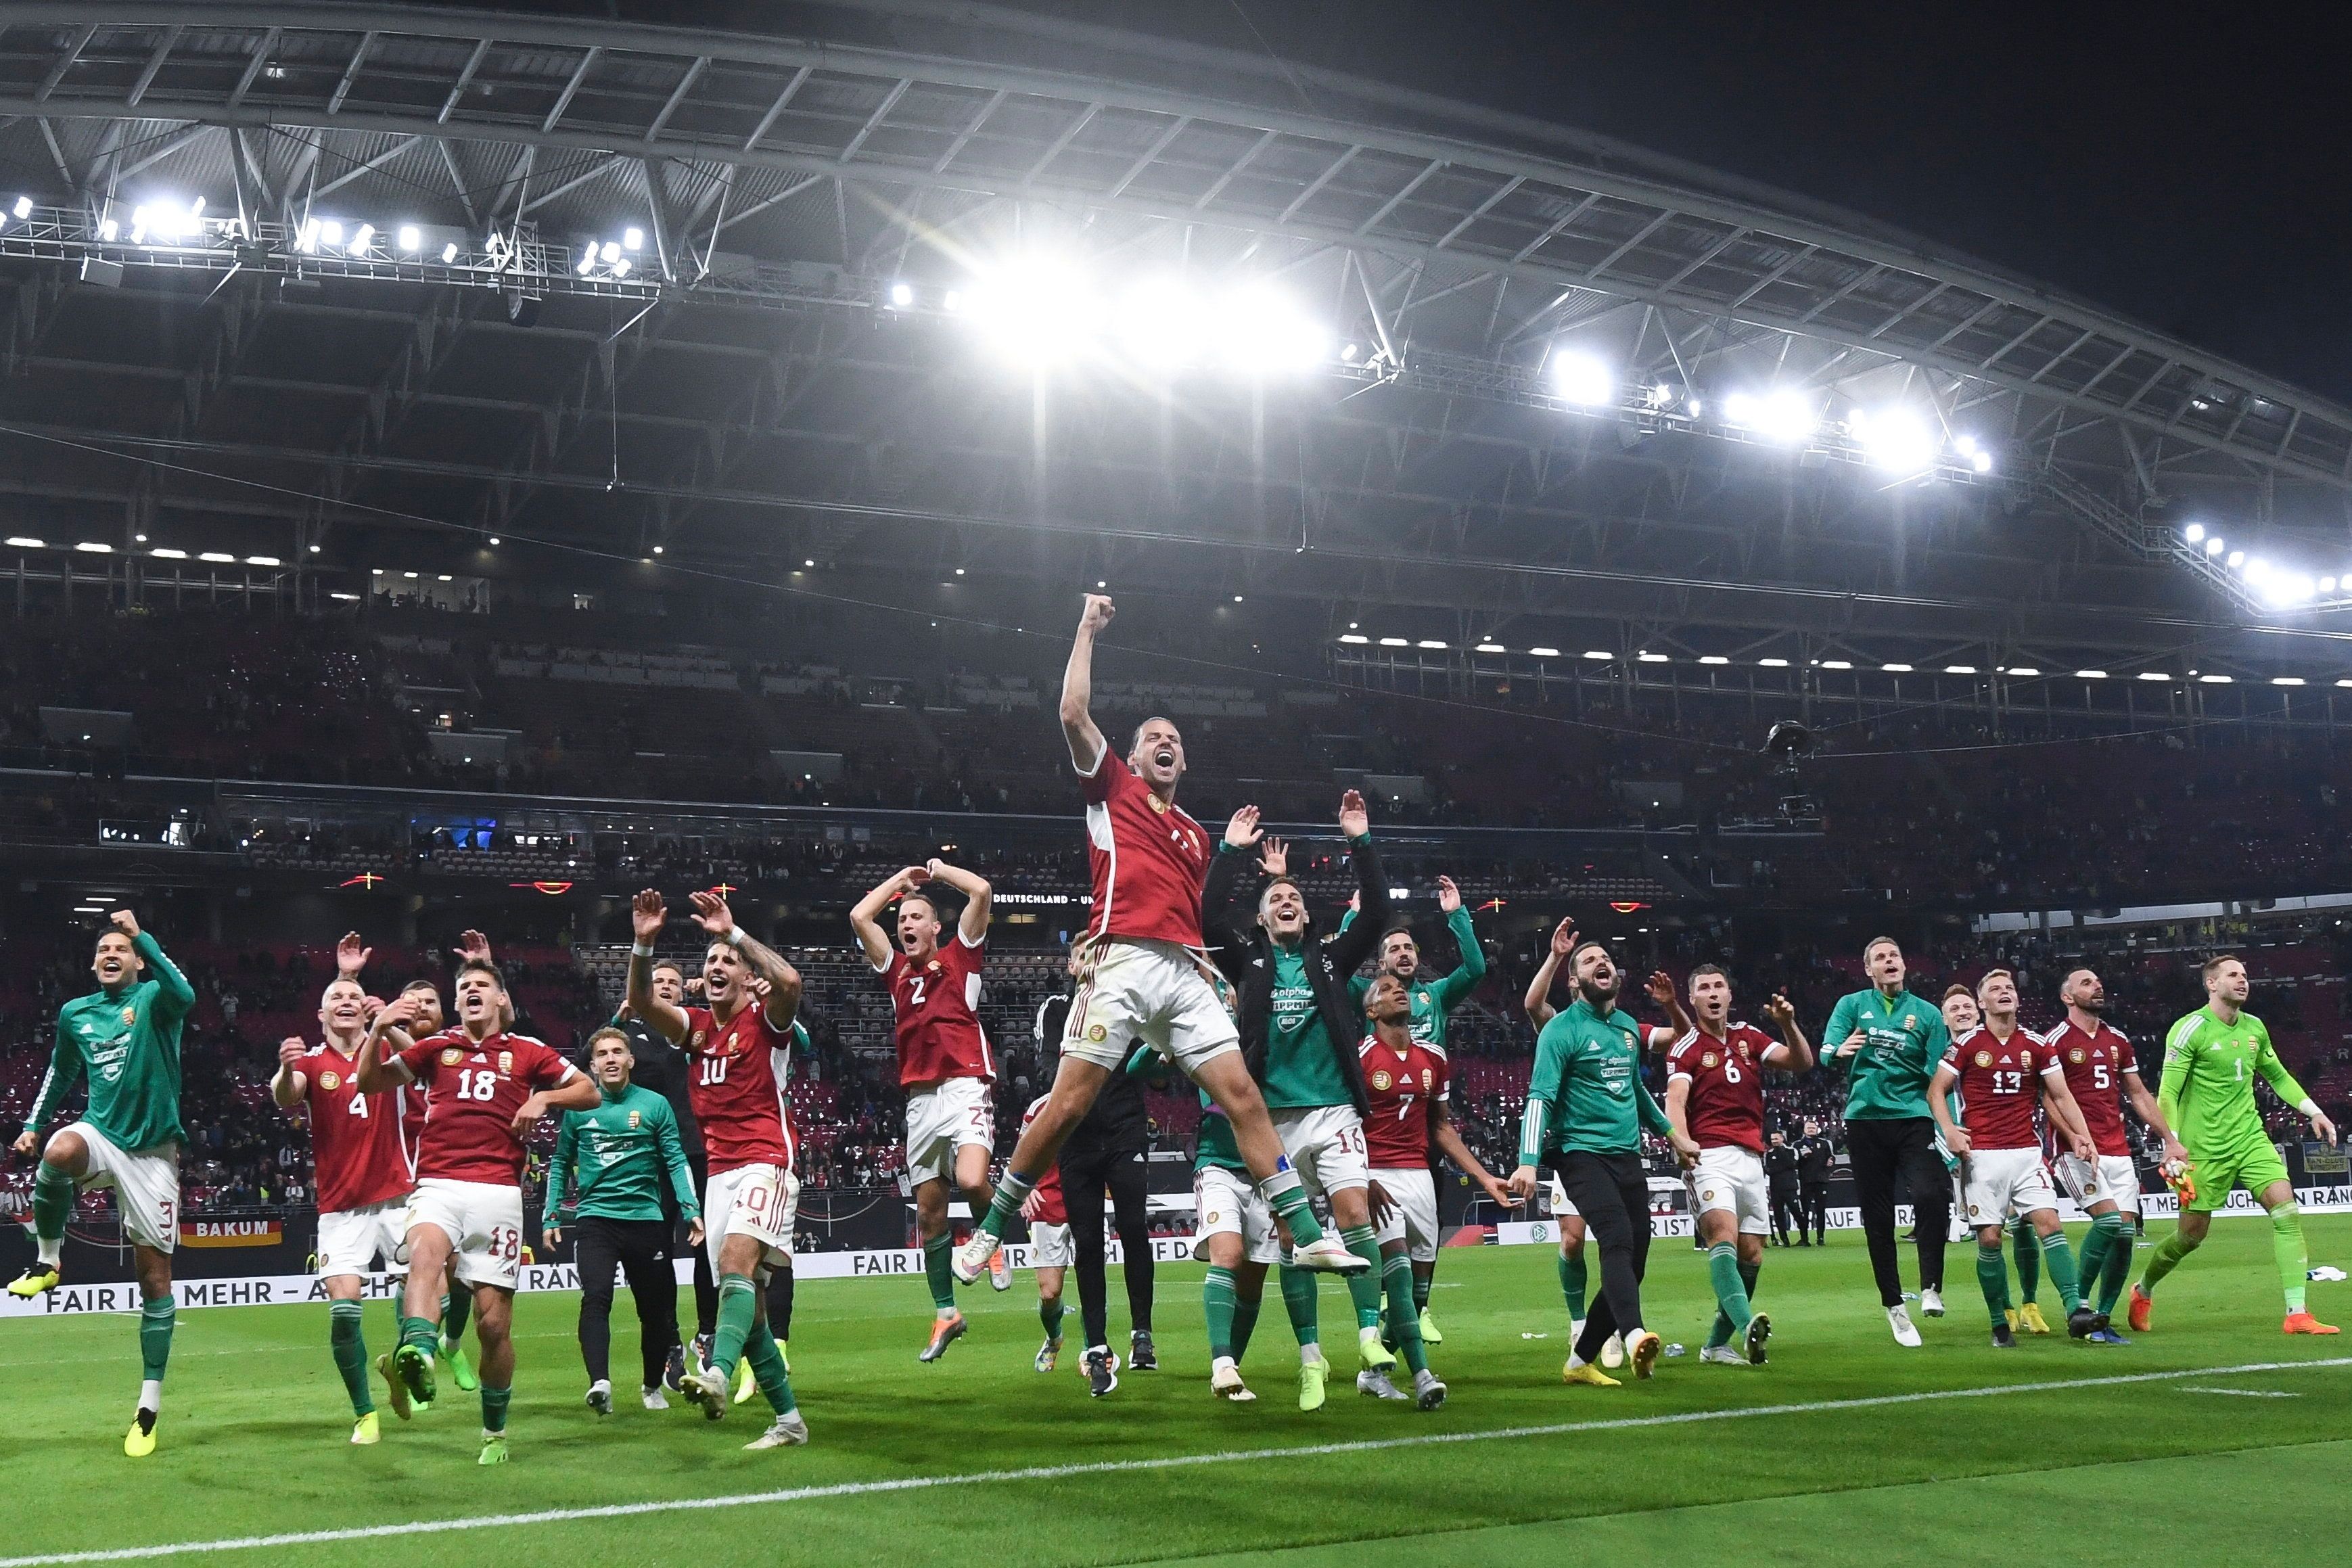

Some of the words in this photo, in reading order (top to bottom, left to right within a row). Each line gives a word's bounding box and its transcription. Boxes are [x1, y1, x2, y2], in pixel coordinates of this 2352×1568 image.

[993, 894, 1068, 904] DEUTSCHLAND
[909, 976, 925, 1005] 2
[699, 1056, 727, 1086] 10
[1724, 1059, 1741, 1083] 6
[2094, 1064, 2110, 1089] 5
[2234, 1057, 2243, 1081] 1
[457, 1068, 497, 1101] 18
[1992, 1070, 2022, 1094] 13
[348, 1092, 368, 1119] 4
[968, 1107, 984, 1127] 2
[1398, 1094, 1414, 1121] 7
[1335, 1127, 1365, 1155] 16
[2313, 1186, 2352, 1205] RÄN
[159, 1201, 172, 1229] 3
[1664, 1218, 1690, 1236] IST
[196, 1220, 269, 1237] BAKUM
[488, 1226, 519, 1260] 18
[854, 1253, 907, 1274] FAIR
[46, 1289, 116, 1314] FAIR
[184, 1282, 272, 1306] MEHR
